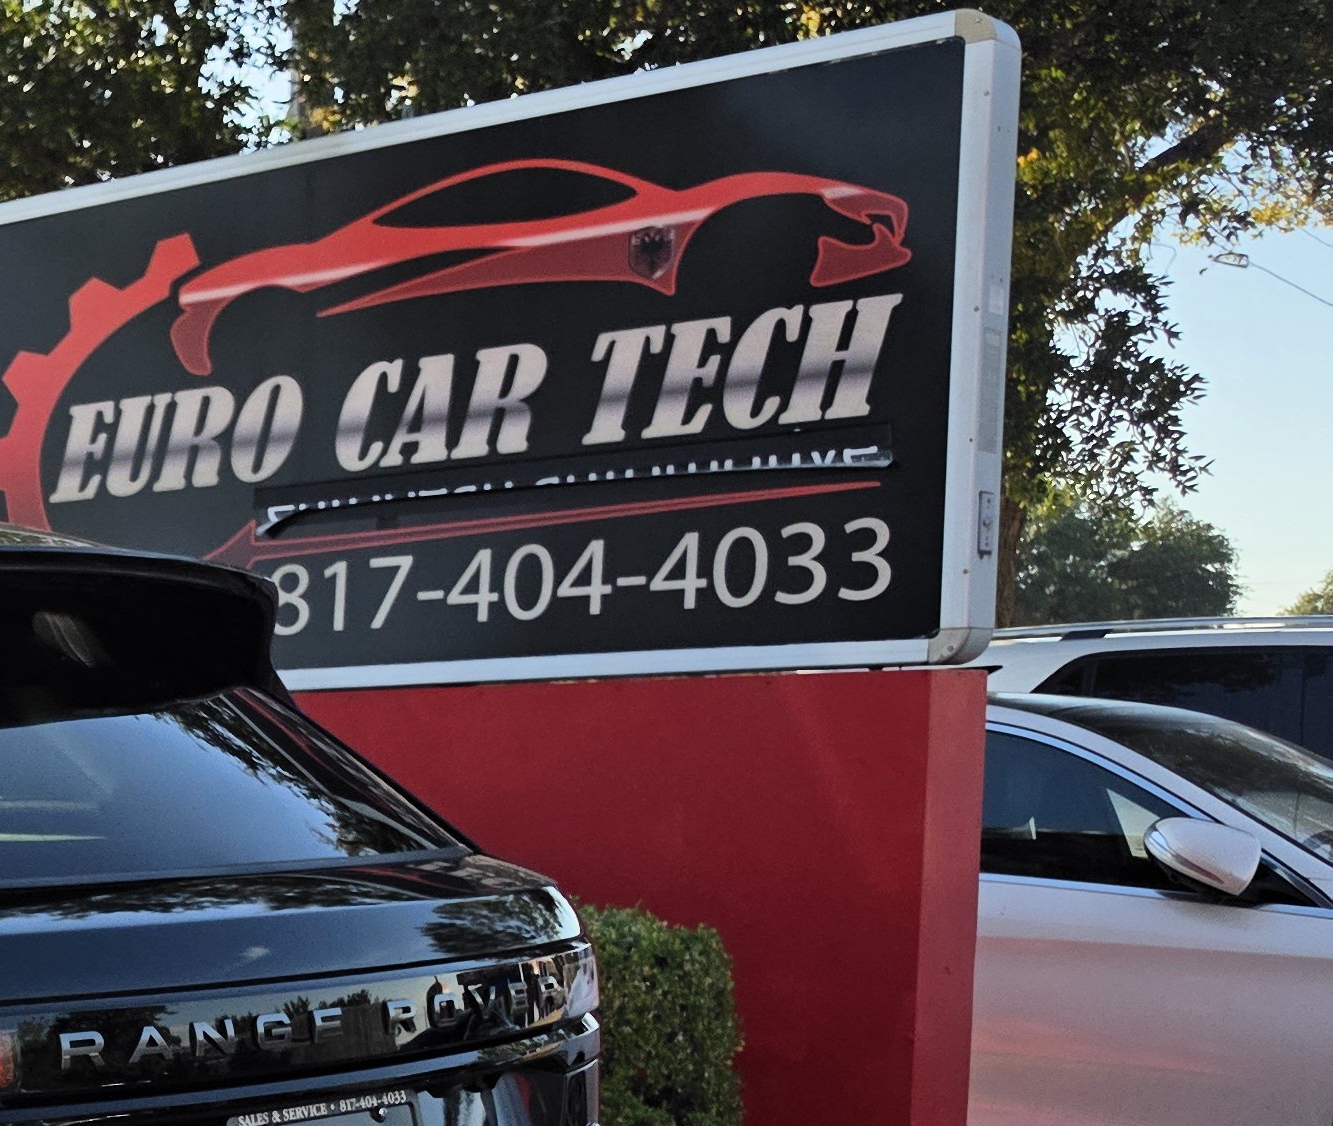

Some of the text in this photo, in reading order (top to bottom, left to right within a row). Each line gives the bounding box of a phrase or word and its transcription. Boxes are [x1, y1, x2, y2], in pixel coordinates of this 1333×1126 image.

[49, 293, 903, 503] EURO CAR TECH
[272, 517, 891, 636] 817-404-4033
[59, 975, 564, 1070] RANGE ROVER
[271, 1110, 282, 1123] &
[283, 1103, 327, 1121] SERVICE
[339, 1091, 406, 1112] 817-404-4033
